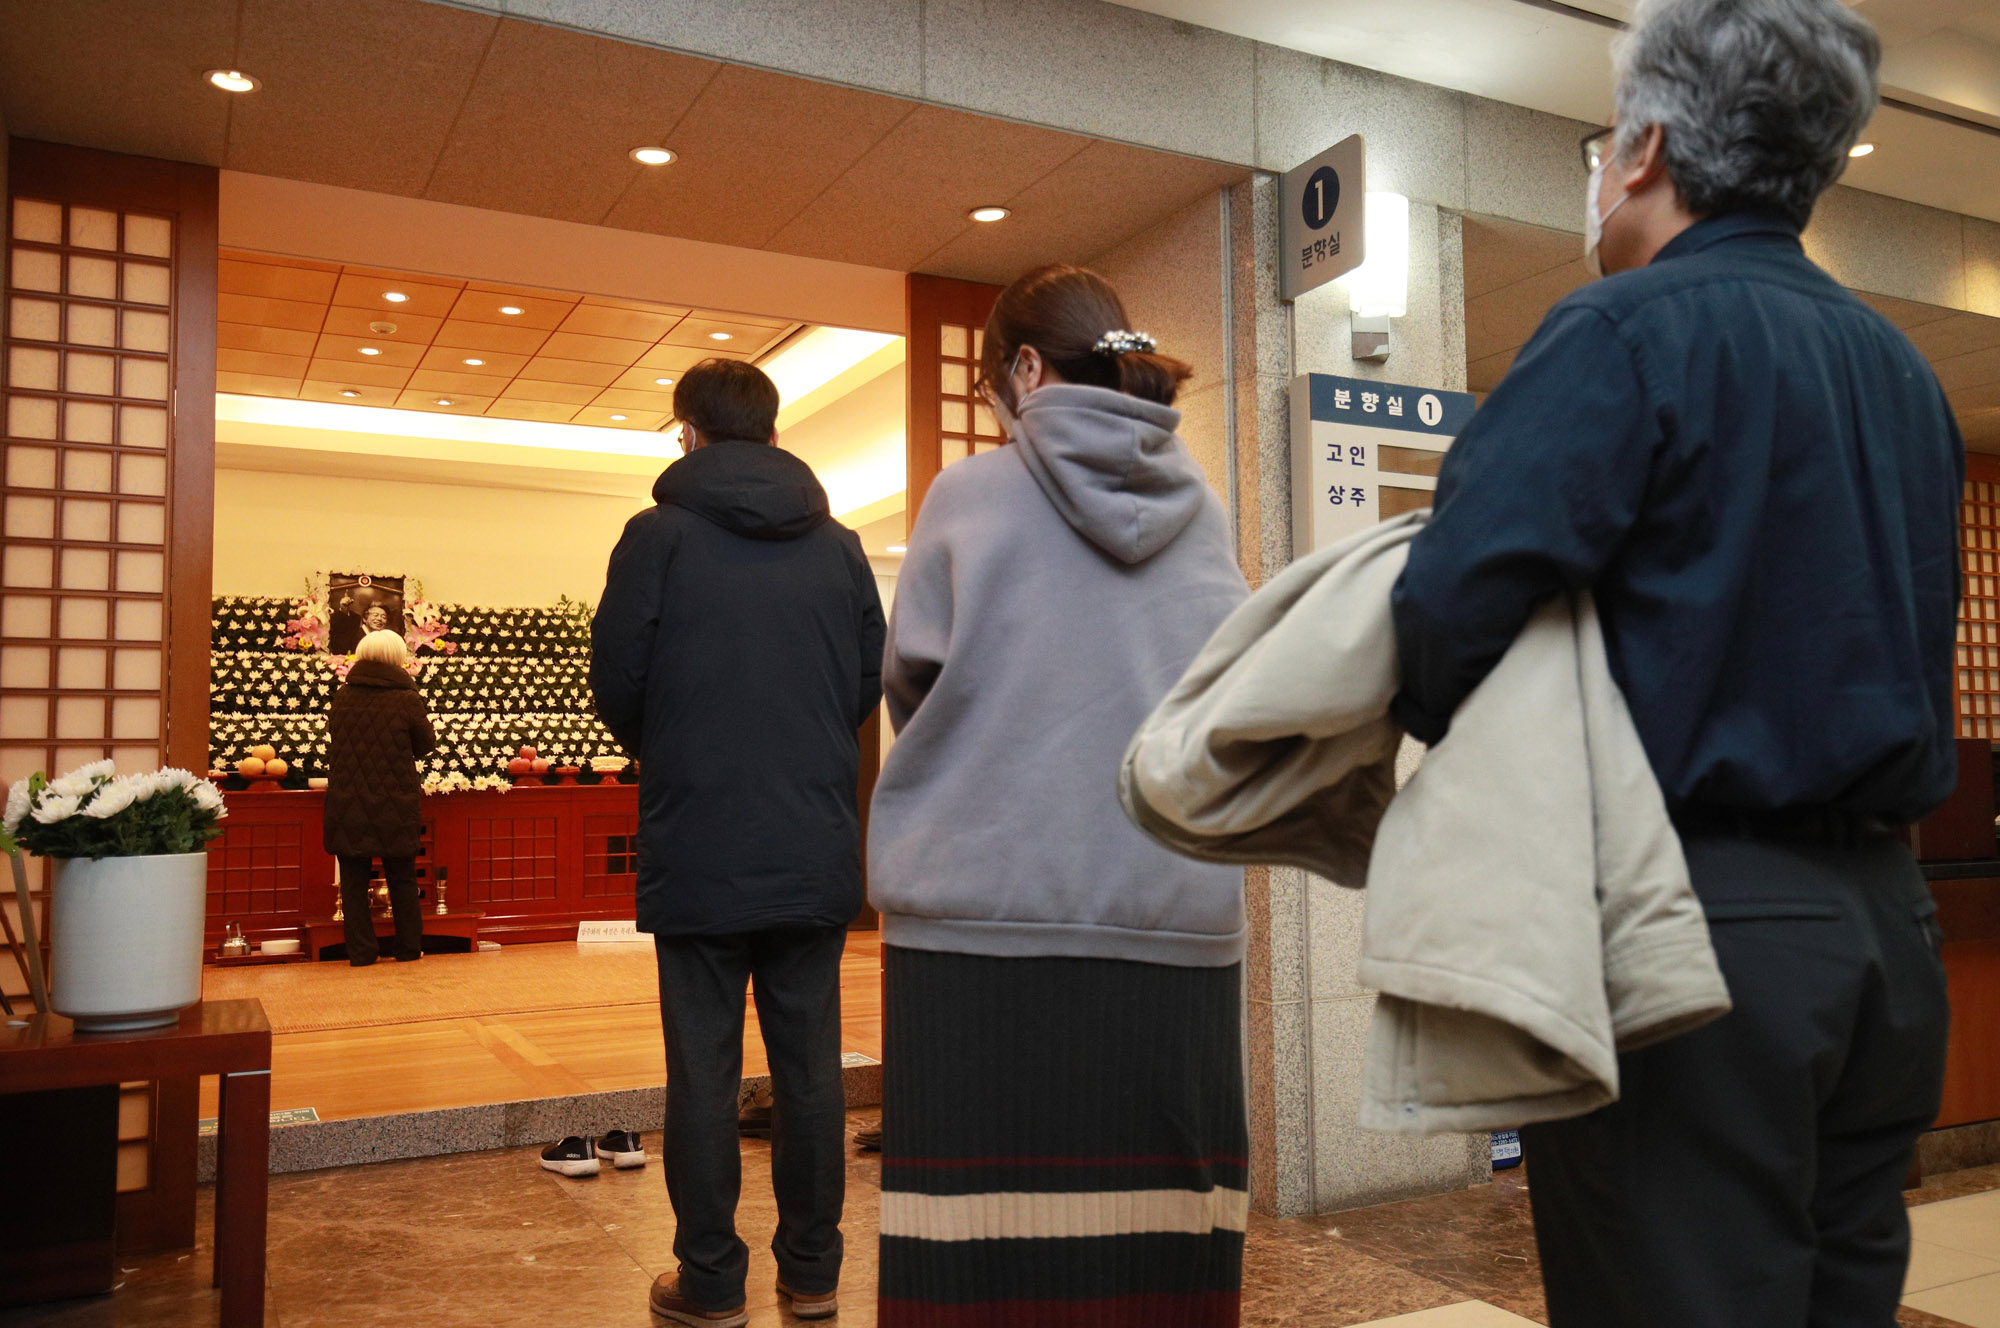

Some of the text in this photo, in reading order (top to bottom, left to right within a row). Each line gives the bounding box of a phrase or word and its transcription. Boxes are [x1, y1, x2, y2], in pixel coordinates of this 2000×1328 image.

[1314, 179, 1324, 221] 1
[1301, 231, 1341, 270] 분향실
[1326, 443, 1365, 467] 고인
[1327, 485, 1366, 507] 상주
